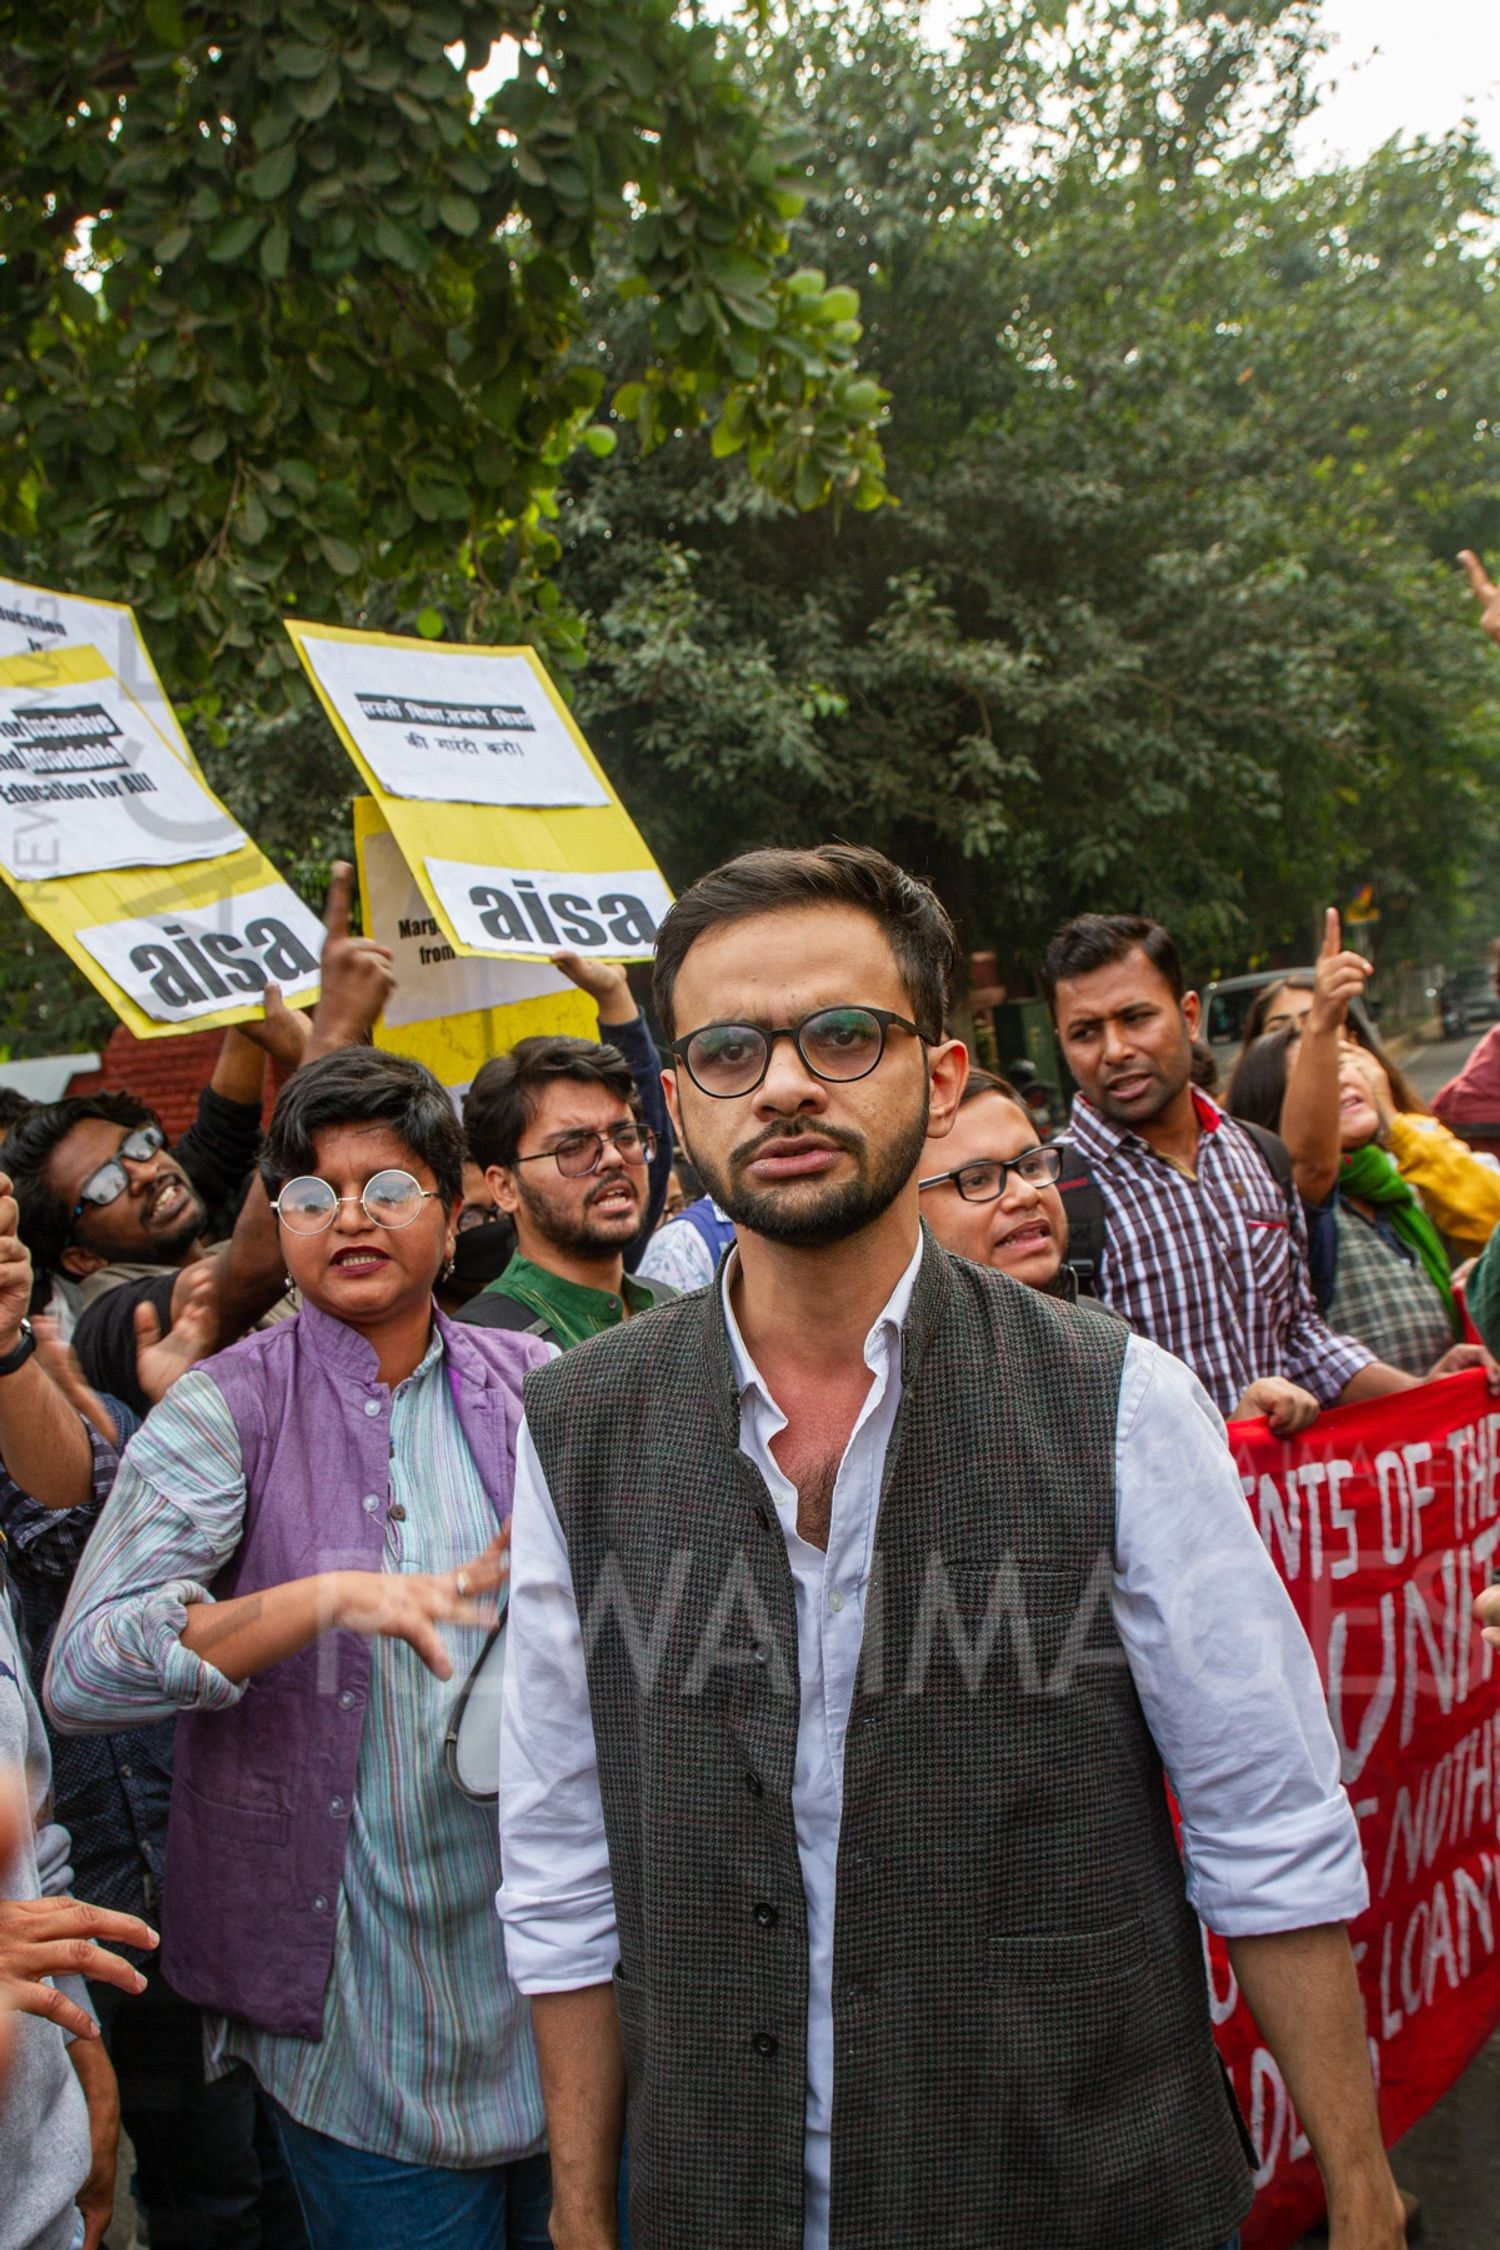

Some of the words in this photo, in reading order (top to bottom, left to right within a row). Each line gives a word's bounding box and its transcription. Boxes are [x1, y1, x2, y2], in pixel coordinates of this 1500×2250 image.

[19, 713, 117, 740] Inclusive
[19, 743, 125, 771] Affordable
[0, 780, 97, 805] Education
[90, 776, 123, 798] for
[119, 772, 158, 795] All!
[468, 877, 660, 947] aisa
[398, 916, 442, 940] Marg
[129, 916, 322, 1008] aisa
[419, 943, 456, 966] from
[1240, 1456, 1360, 1581] NTS
[1374, 1441, 1436, 1566] OF
